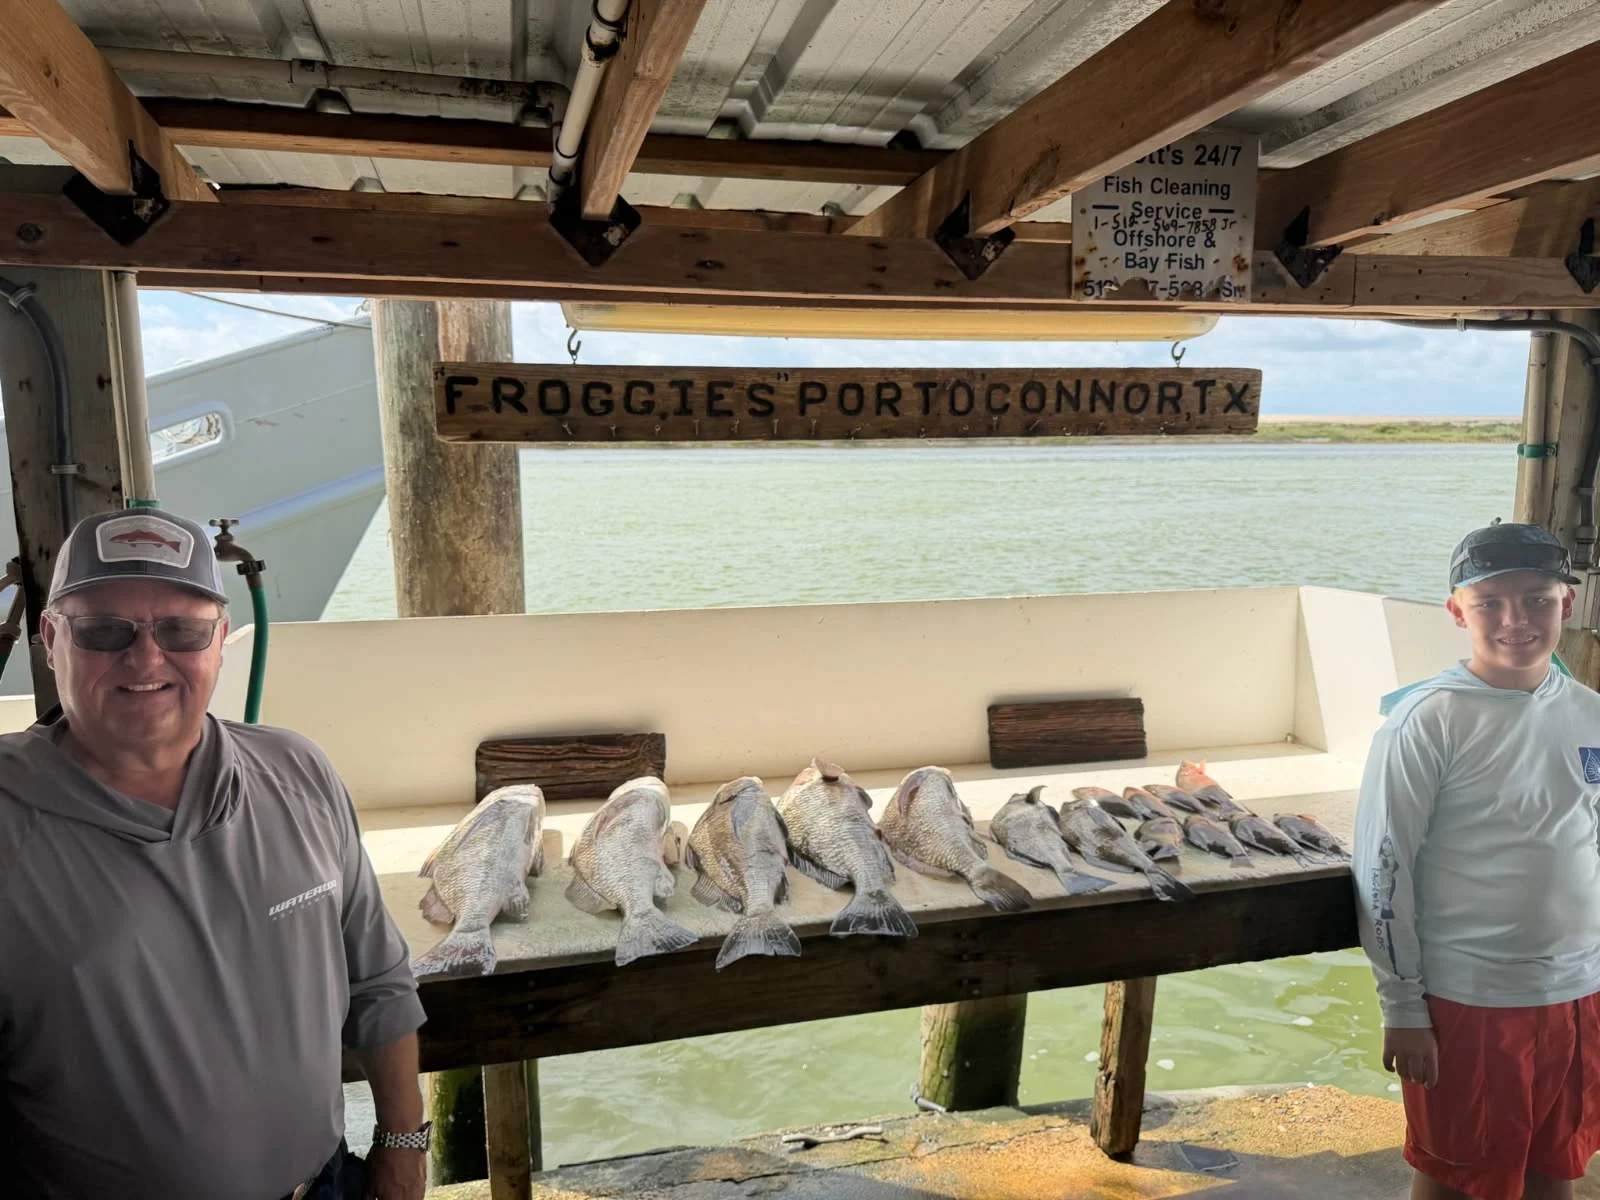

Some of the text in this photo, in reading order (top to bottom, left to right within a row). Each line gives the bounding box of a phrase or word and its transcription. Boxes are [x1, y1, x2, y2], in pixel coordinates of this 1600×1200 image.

[1194, 145, 1242, 167] 24/7
[1104, 176, 1231, 200] Fish Cleaning
[1131, 201, 1203, 220] Service
[1114, 229, 1216, 248] Offshore &
[1125, 252, 1205, 273] Bay Fish
[1193, 378, 1250, 415] TX
